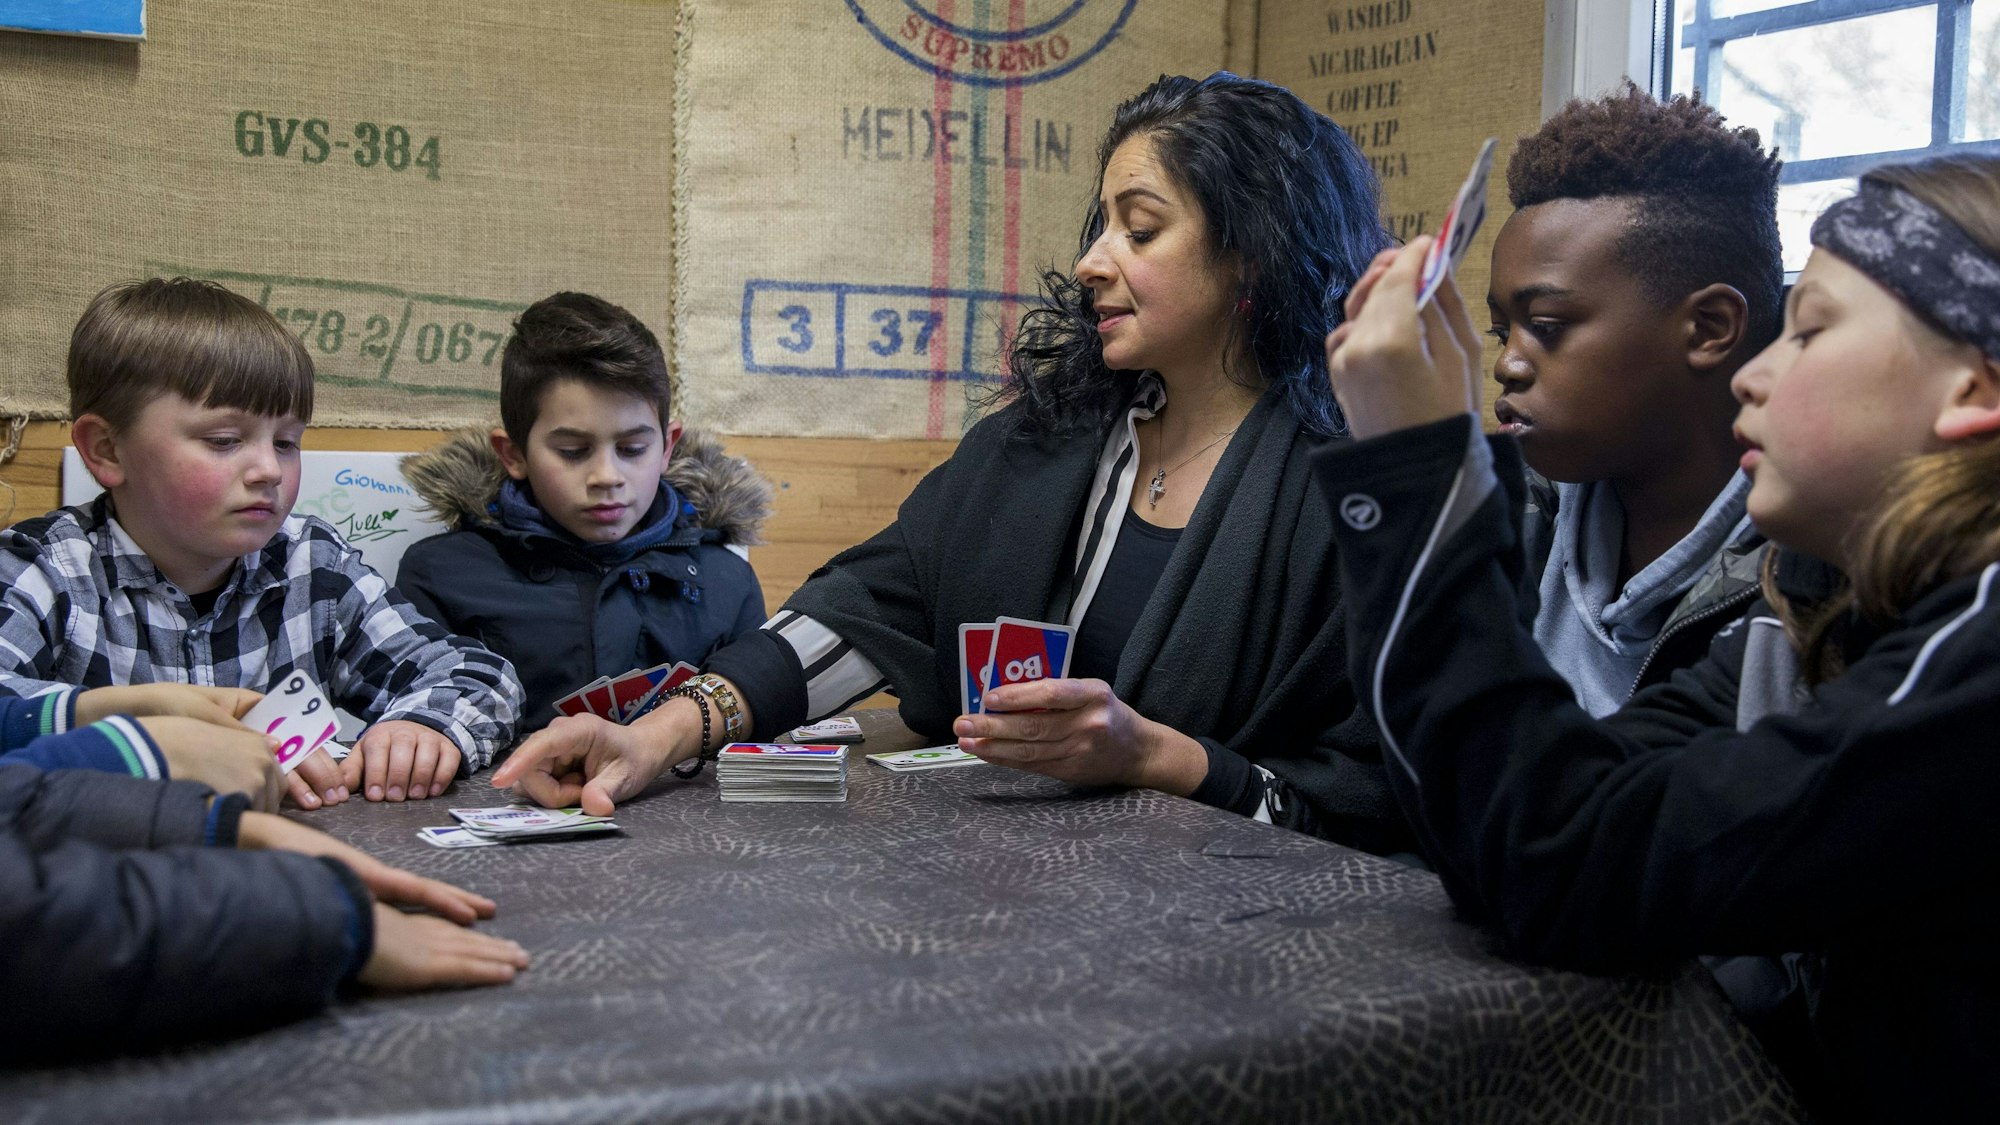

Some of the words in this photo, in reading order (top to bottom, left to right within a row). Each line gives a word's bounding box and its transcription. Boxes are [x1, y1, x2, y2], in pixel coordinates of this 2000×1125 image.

[1327, 0, 1412, 34] WASHED
[899, 13, 1070, 72] SUPREMO
[1308, 30, 1439, 77] NICARAGUAN
[1327, 79, 1402, 112] COFFEE
[234, 110, 442, 180] GVS-384
[842, 106, 1071, 173] MEDELLIN
[1372, 119, 1399, 147] EP
[777, 305, 813, 353] 3
[868, 309, 942, 356] 37
[284, 676, 306, 695] 9
[302, 697, 321, 716] 9
